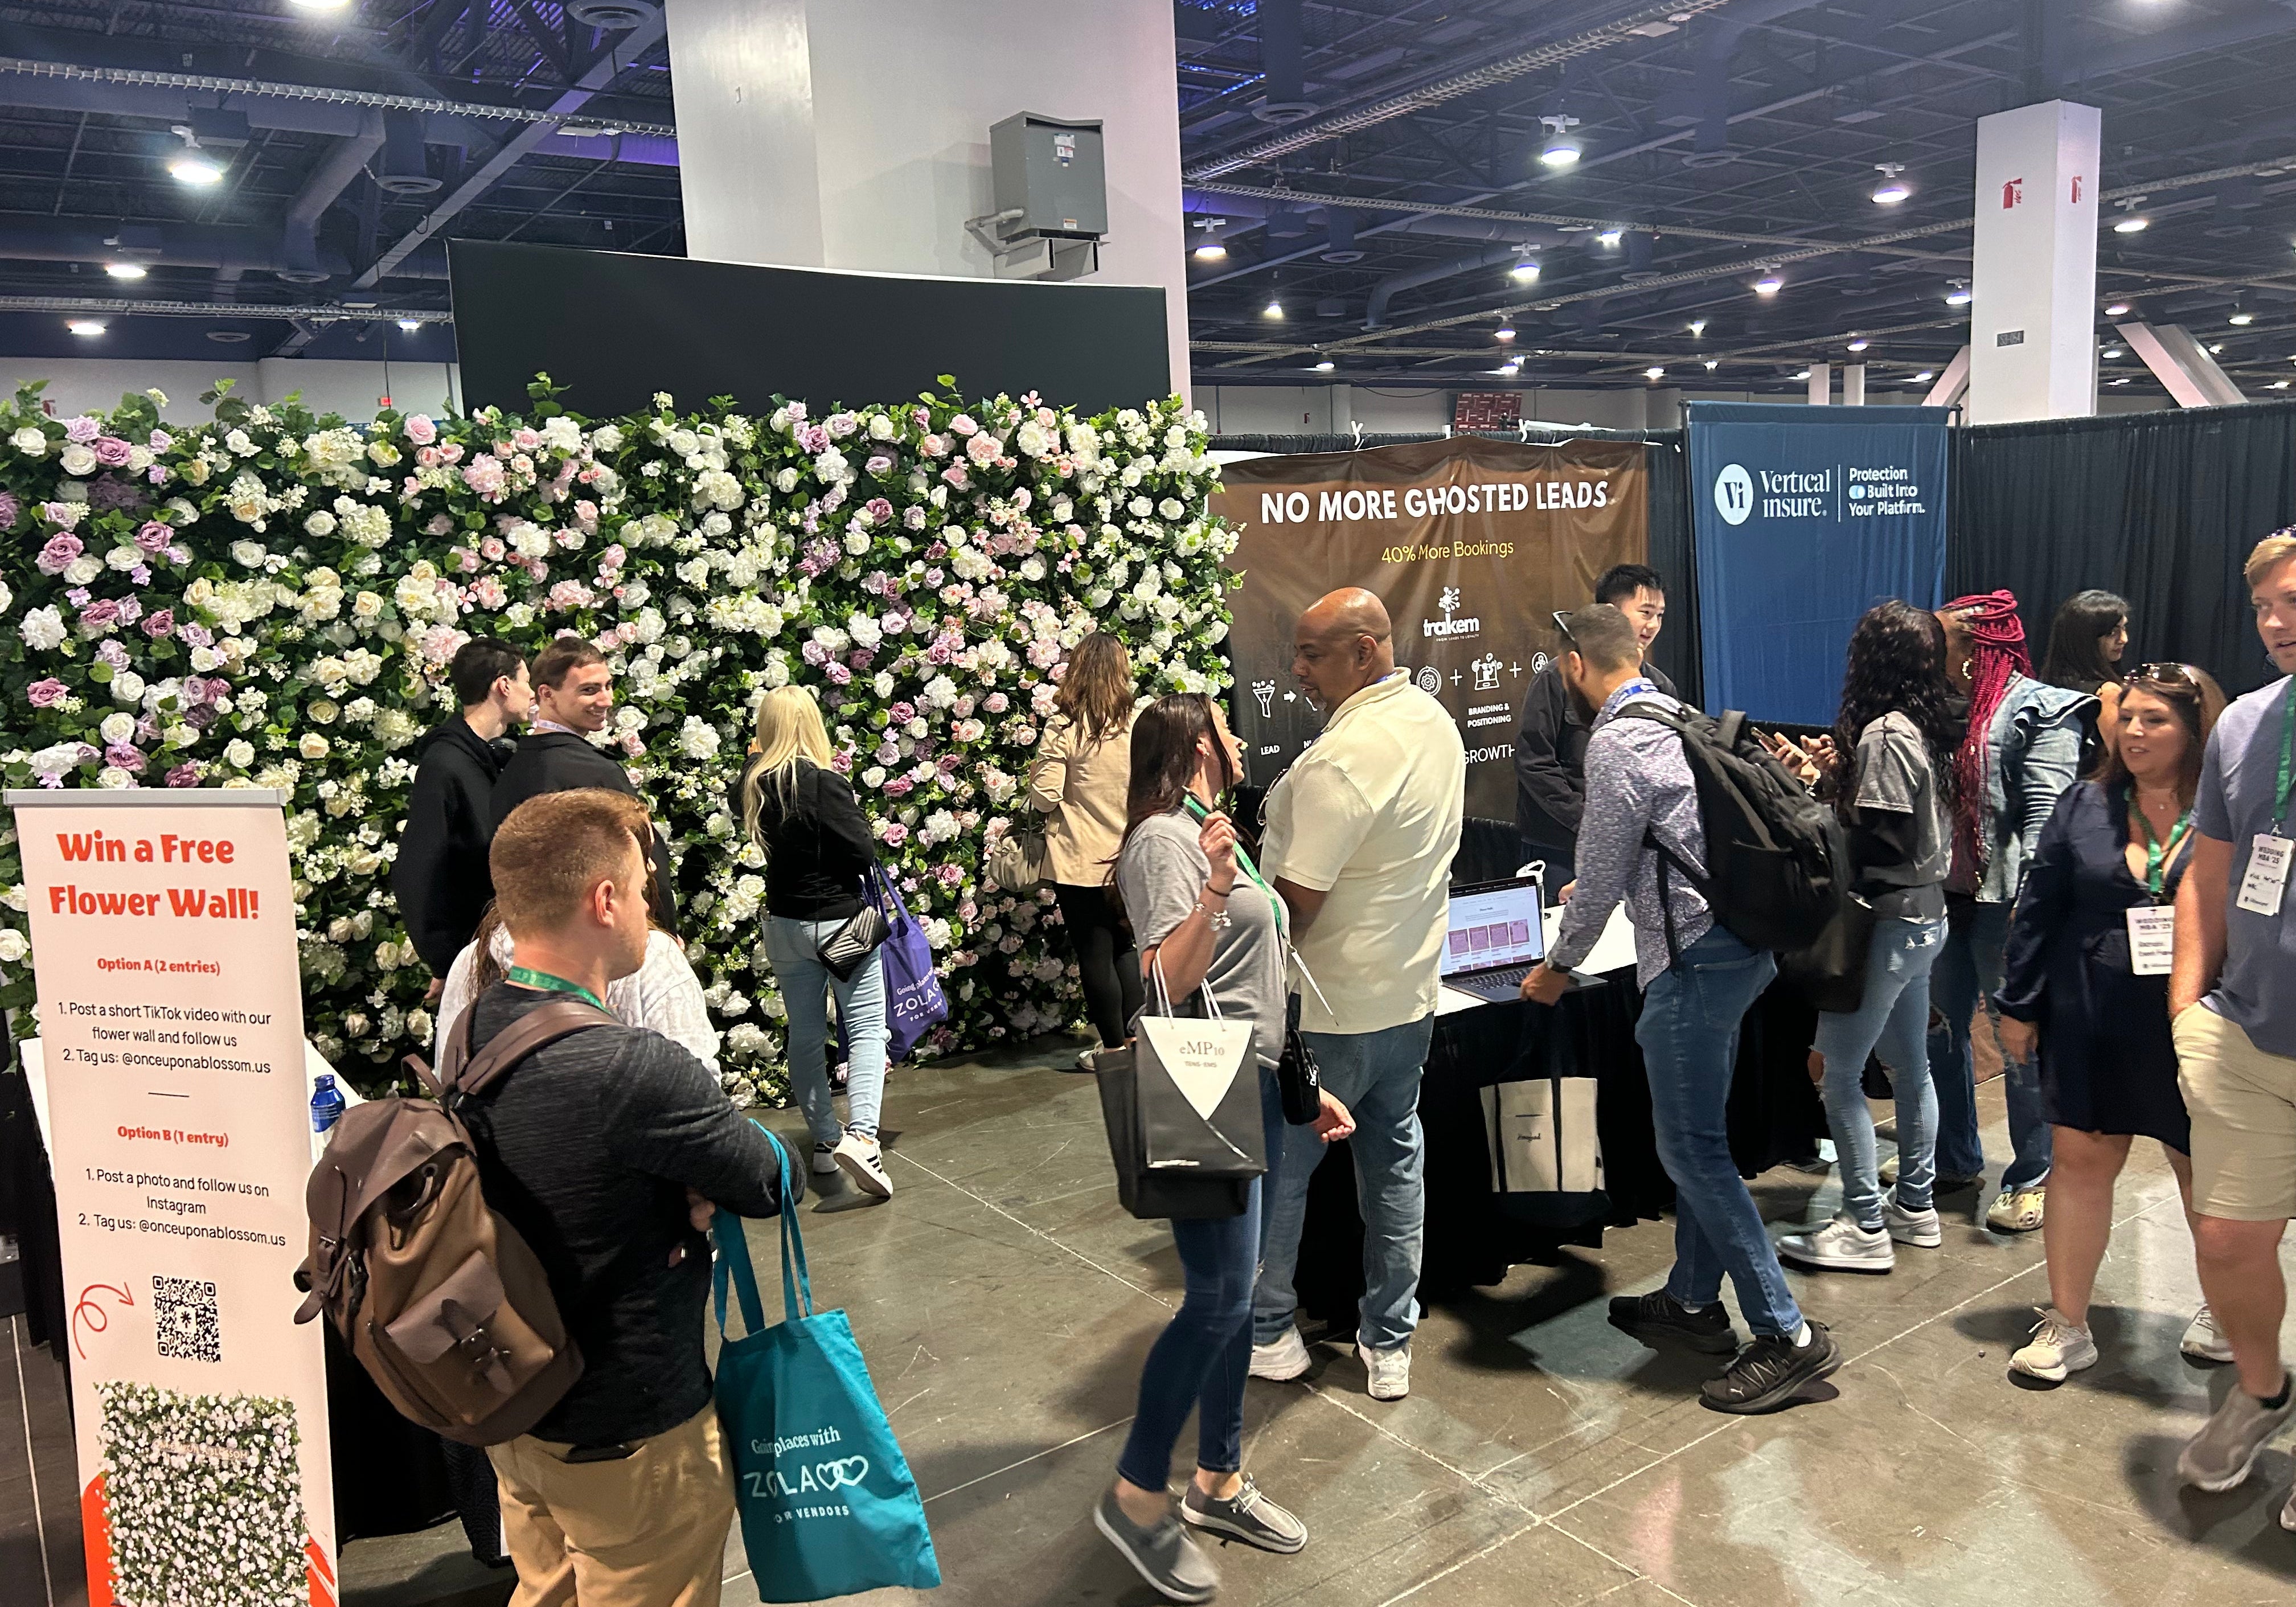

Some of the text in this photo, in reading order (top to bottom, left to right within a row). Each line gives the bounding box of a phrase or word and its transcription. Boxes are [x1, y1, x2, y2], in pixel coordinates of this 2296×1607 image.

[1760, 468, 1831, 494] Vertical
[1850, 466, 1908, 481] Protection
[1724, 481, 1744, 509] Vi
[1868, 483, 1918, 498] Built Into
[1262, 481, 1608, 523] NO MORE GHOSTED LEADS
[1848, 502, 1874, 516] Your
[1381, 539, 1515, 564] 40% More Bookings
[1424, 613, 1479, 638] trakem
[1469, 704, 1503, 715] BRANDING
[1467, 715, 1511, 727] POSITIONING
[1261, 745, 1280, 755] LEAD
[57, 830, 233, 863] Win a Free
[49, 885, 258, 919] Flower Wall!
[98, 958, 220, 976] Option A (2 entries)
[897, 983, 916, 995] Going
[59, 1002, 271, 1024] 1. Post a short TikTok video with our
[893, 989, 936, 1017] ZOLA
[910, 1012, 924, 1022] FOR
[92, 1027, 237, 1047] flower wall and follow us
[63, 1049, 270, 1073] 2. Tag us: @onceuponablossom.us
[118, 1126, 229, 1148] Option B (1 entry)
[86, 1169, 269, 1196] 1. Post a photo and follow us on
[147, 1196, 206, 1215] Instagram
[79, 1213, 285, 1246] 2. Tag us: @onceuponablossom.us
[774, 1434, 810, 1458] places
[809, 1425, 842, 1446] with
[743, 1465, 819, 1498] ZOLA
[774, 1505, 850, 1524] OR VENDORS
